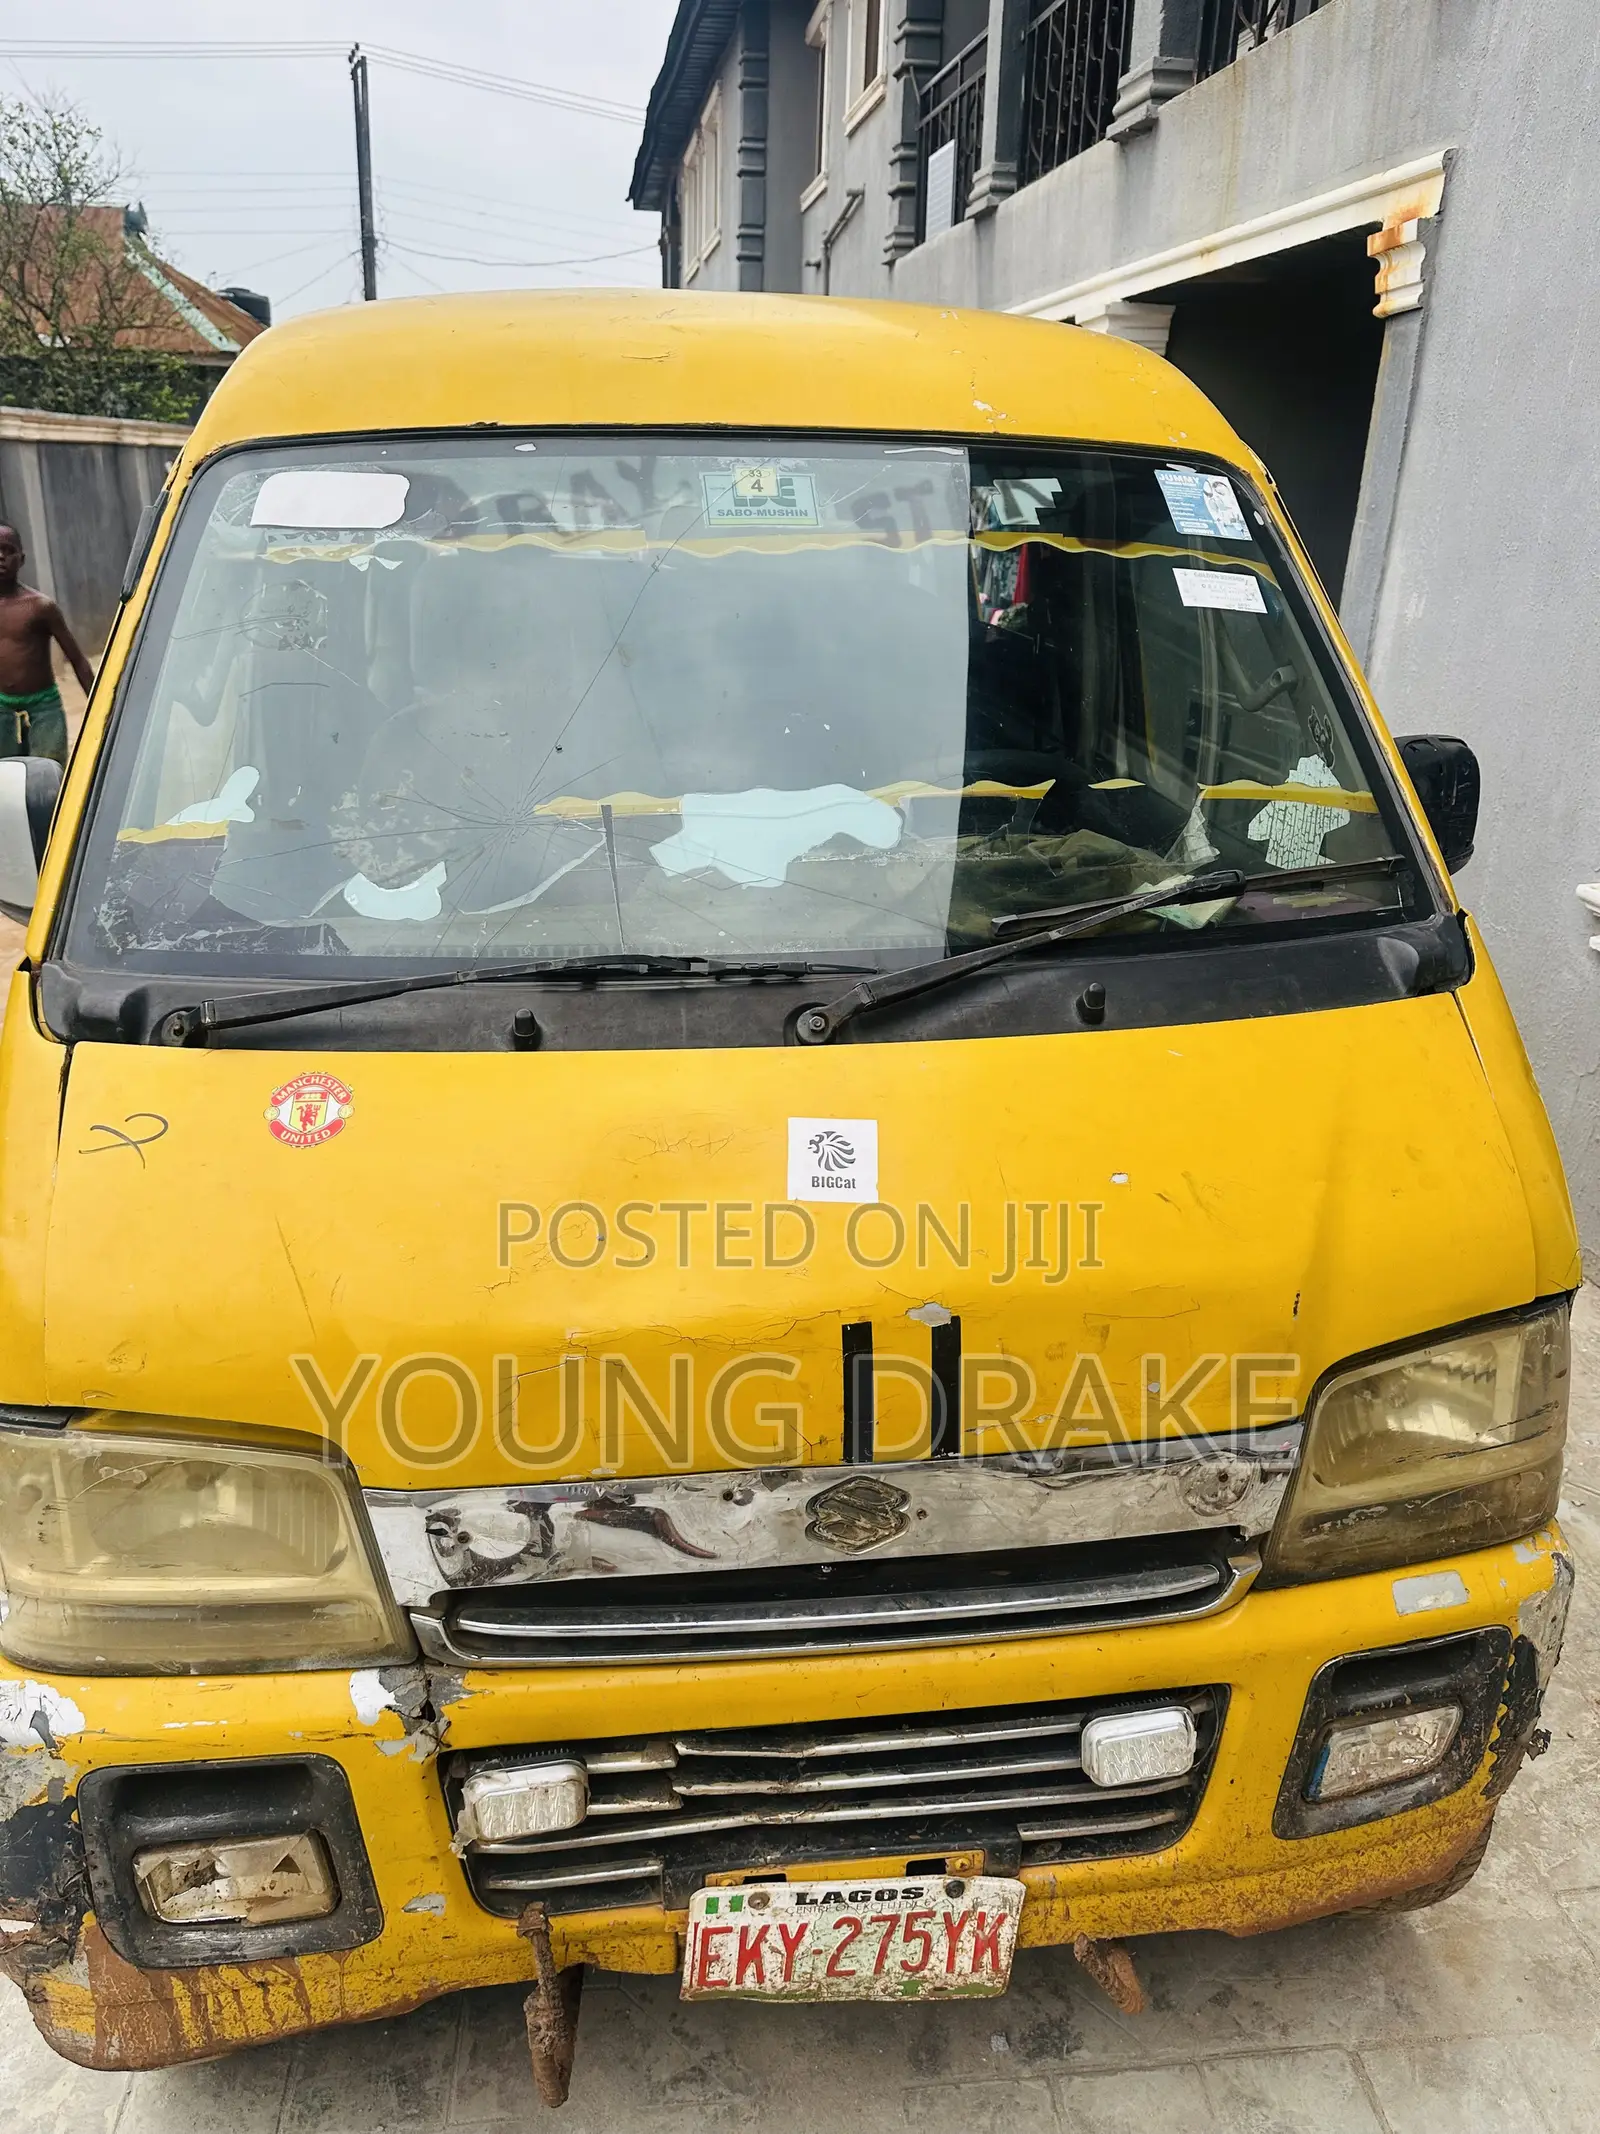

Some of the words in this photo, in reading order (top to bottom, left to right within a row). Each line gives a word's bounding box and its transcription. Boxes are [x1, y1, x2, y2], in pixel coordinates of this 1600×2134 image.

[748, 469, 762, 478] 33
[1159, 473, 1200, 485] JUMMY
[751, 479, 764, 492] 4
[716, 508, 808, 517] SABO-MUSHIN
[275, 1075, 347, 1101] MANCHESTER
[280, 1129, 331, 1144] UNITED
[811, 1175, 857, 1189] BIGCat
[794, 1887, 925, 1906] LAGOS
[785, 1904, 830, 1917] CENTRE
[836, 1902, 854, 1913] OF
[696, 1910, 1009, 1988] EKY-275YK
